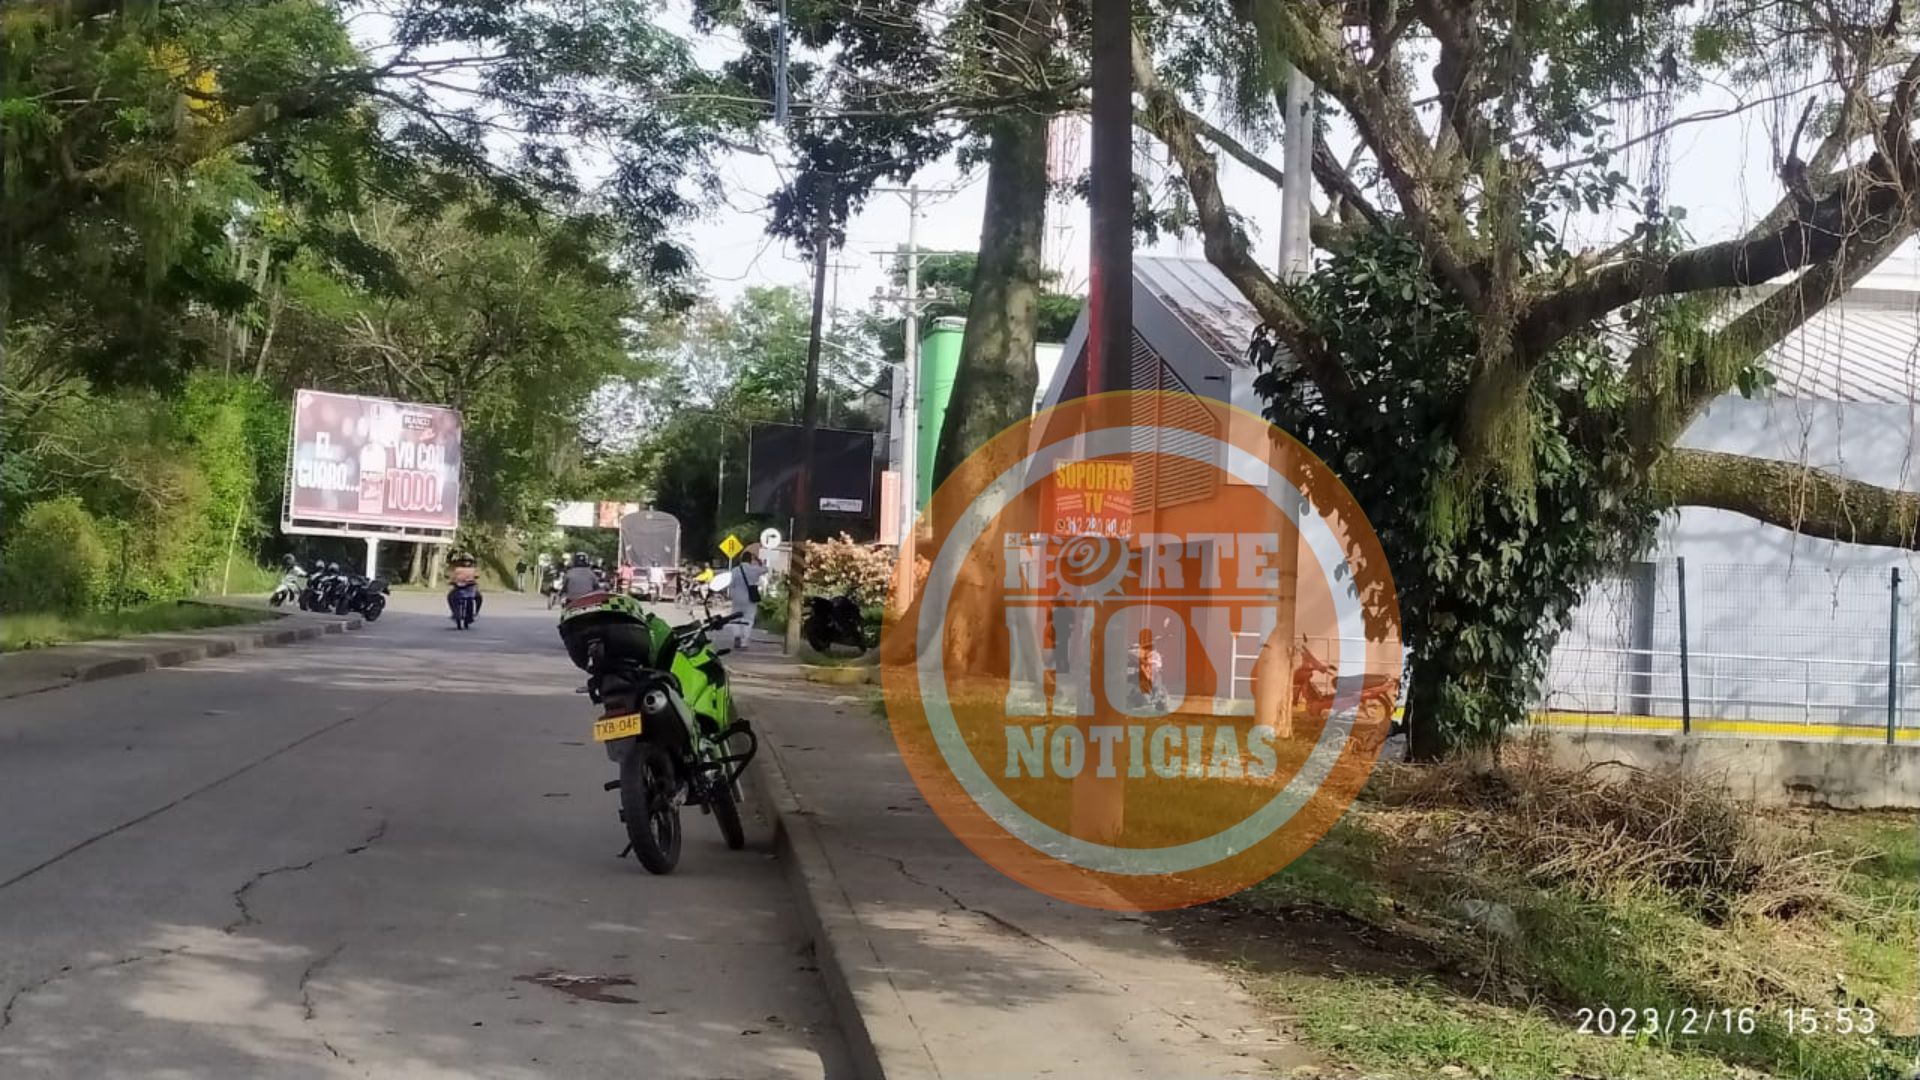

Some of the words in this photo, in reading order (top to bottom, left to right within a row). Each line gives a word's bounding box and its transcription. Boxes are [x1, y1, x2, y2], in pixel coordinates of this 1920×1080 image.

[396, 442, 414, 468] VA
[416, 443, 446, 471] CON
[1084, 492, 1104, 514] TV
